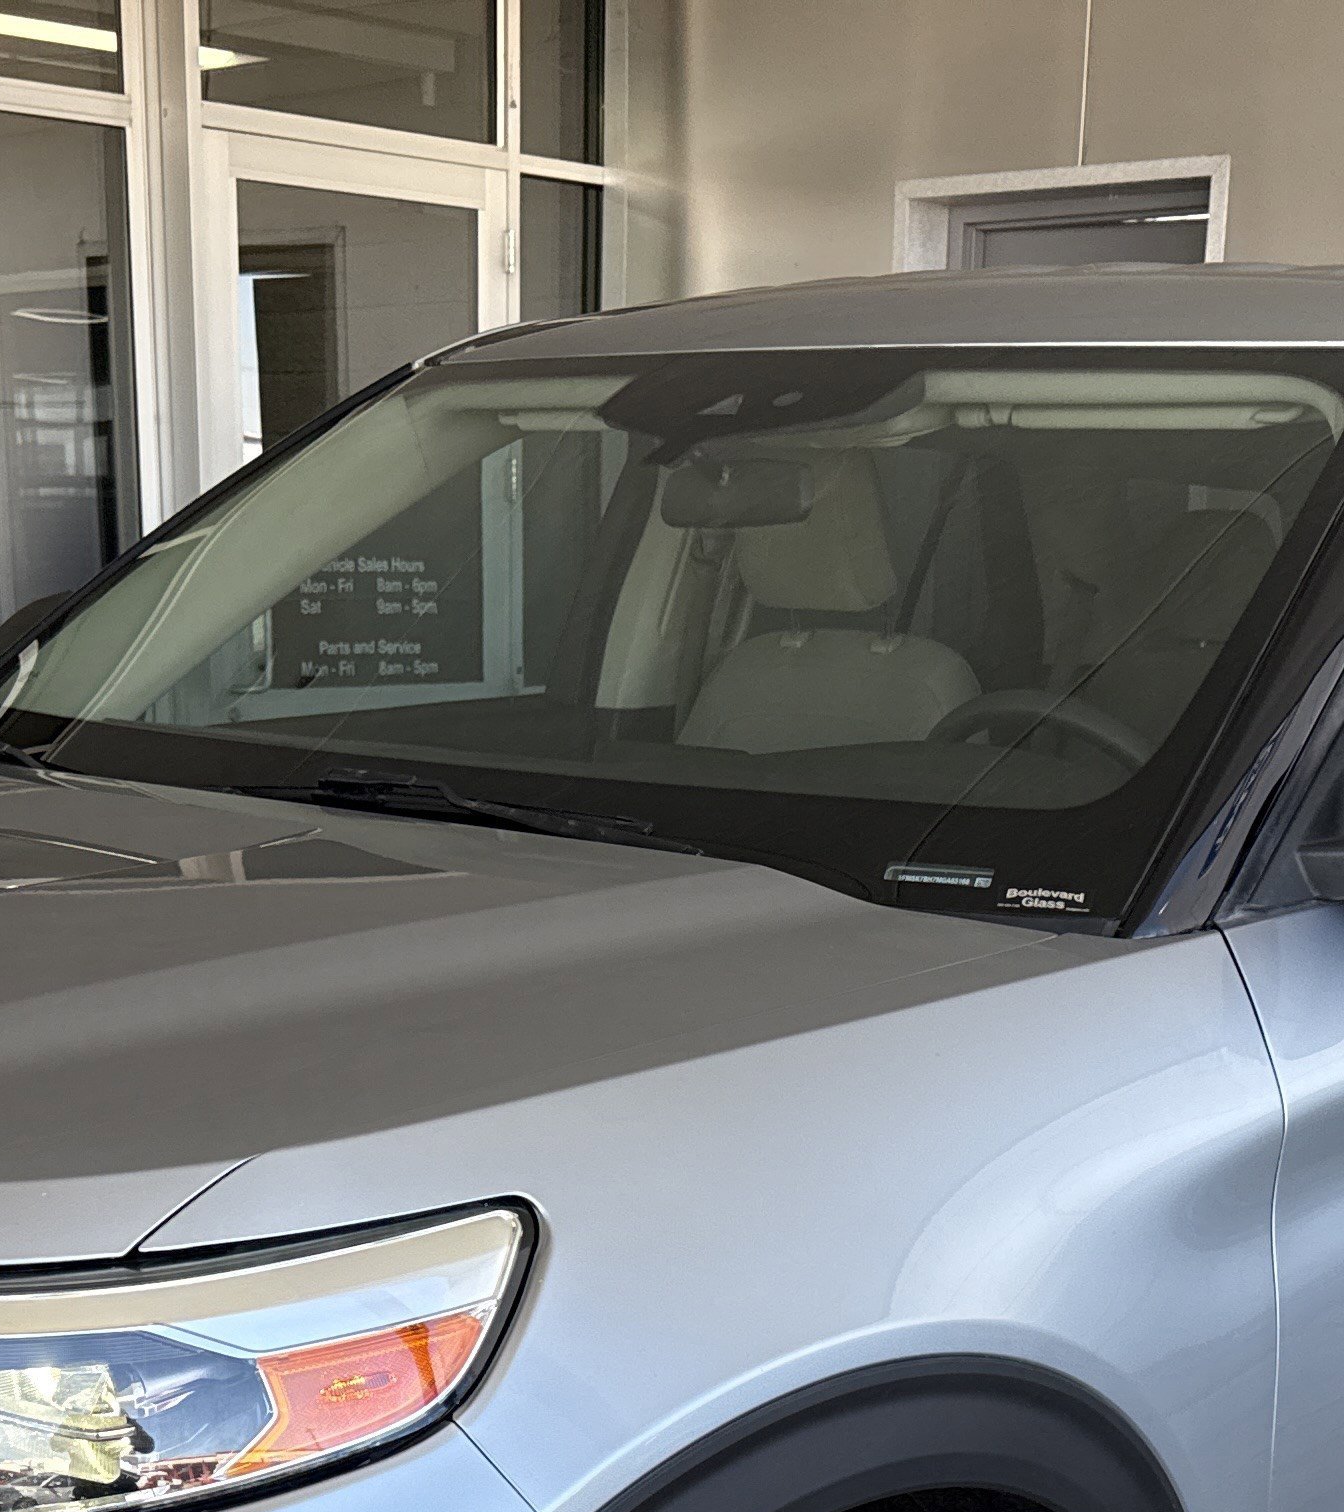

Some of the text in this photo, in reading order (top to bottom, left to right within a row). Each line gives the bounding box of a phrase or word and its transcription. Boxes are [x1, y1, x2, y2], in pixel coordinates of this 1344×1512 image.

[357, 557, 389, 573] Sales
[391, 556, 425, 573] Hours
[337, 578, 354, 592] Fri
[300, 599, 322, 615] Sat
[319, 640, 422, 655] Parts and Service
[338, 661, 355, 676] Fri
[1006, 888, 1084, 903] Boulevard
[1021, 897, 1065, 909] Glass
